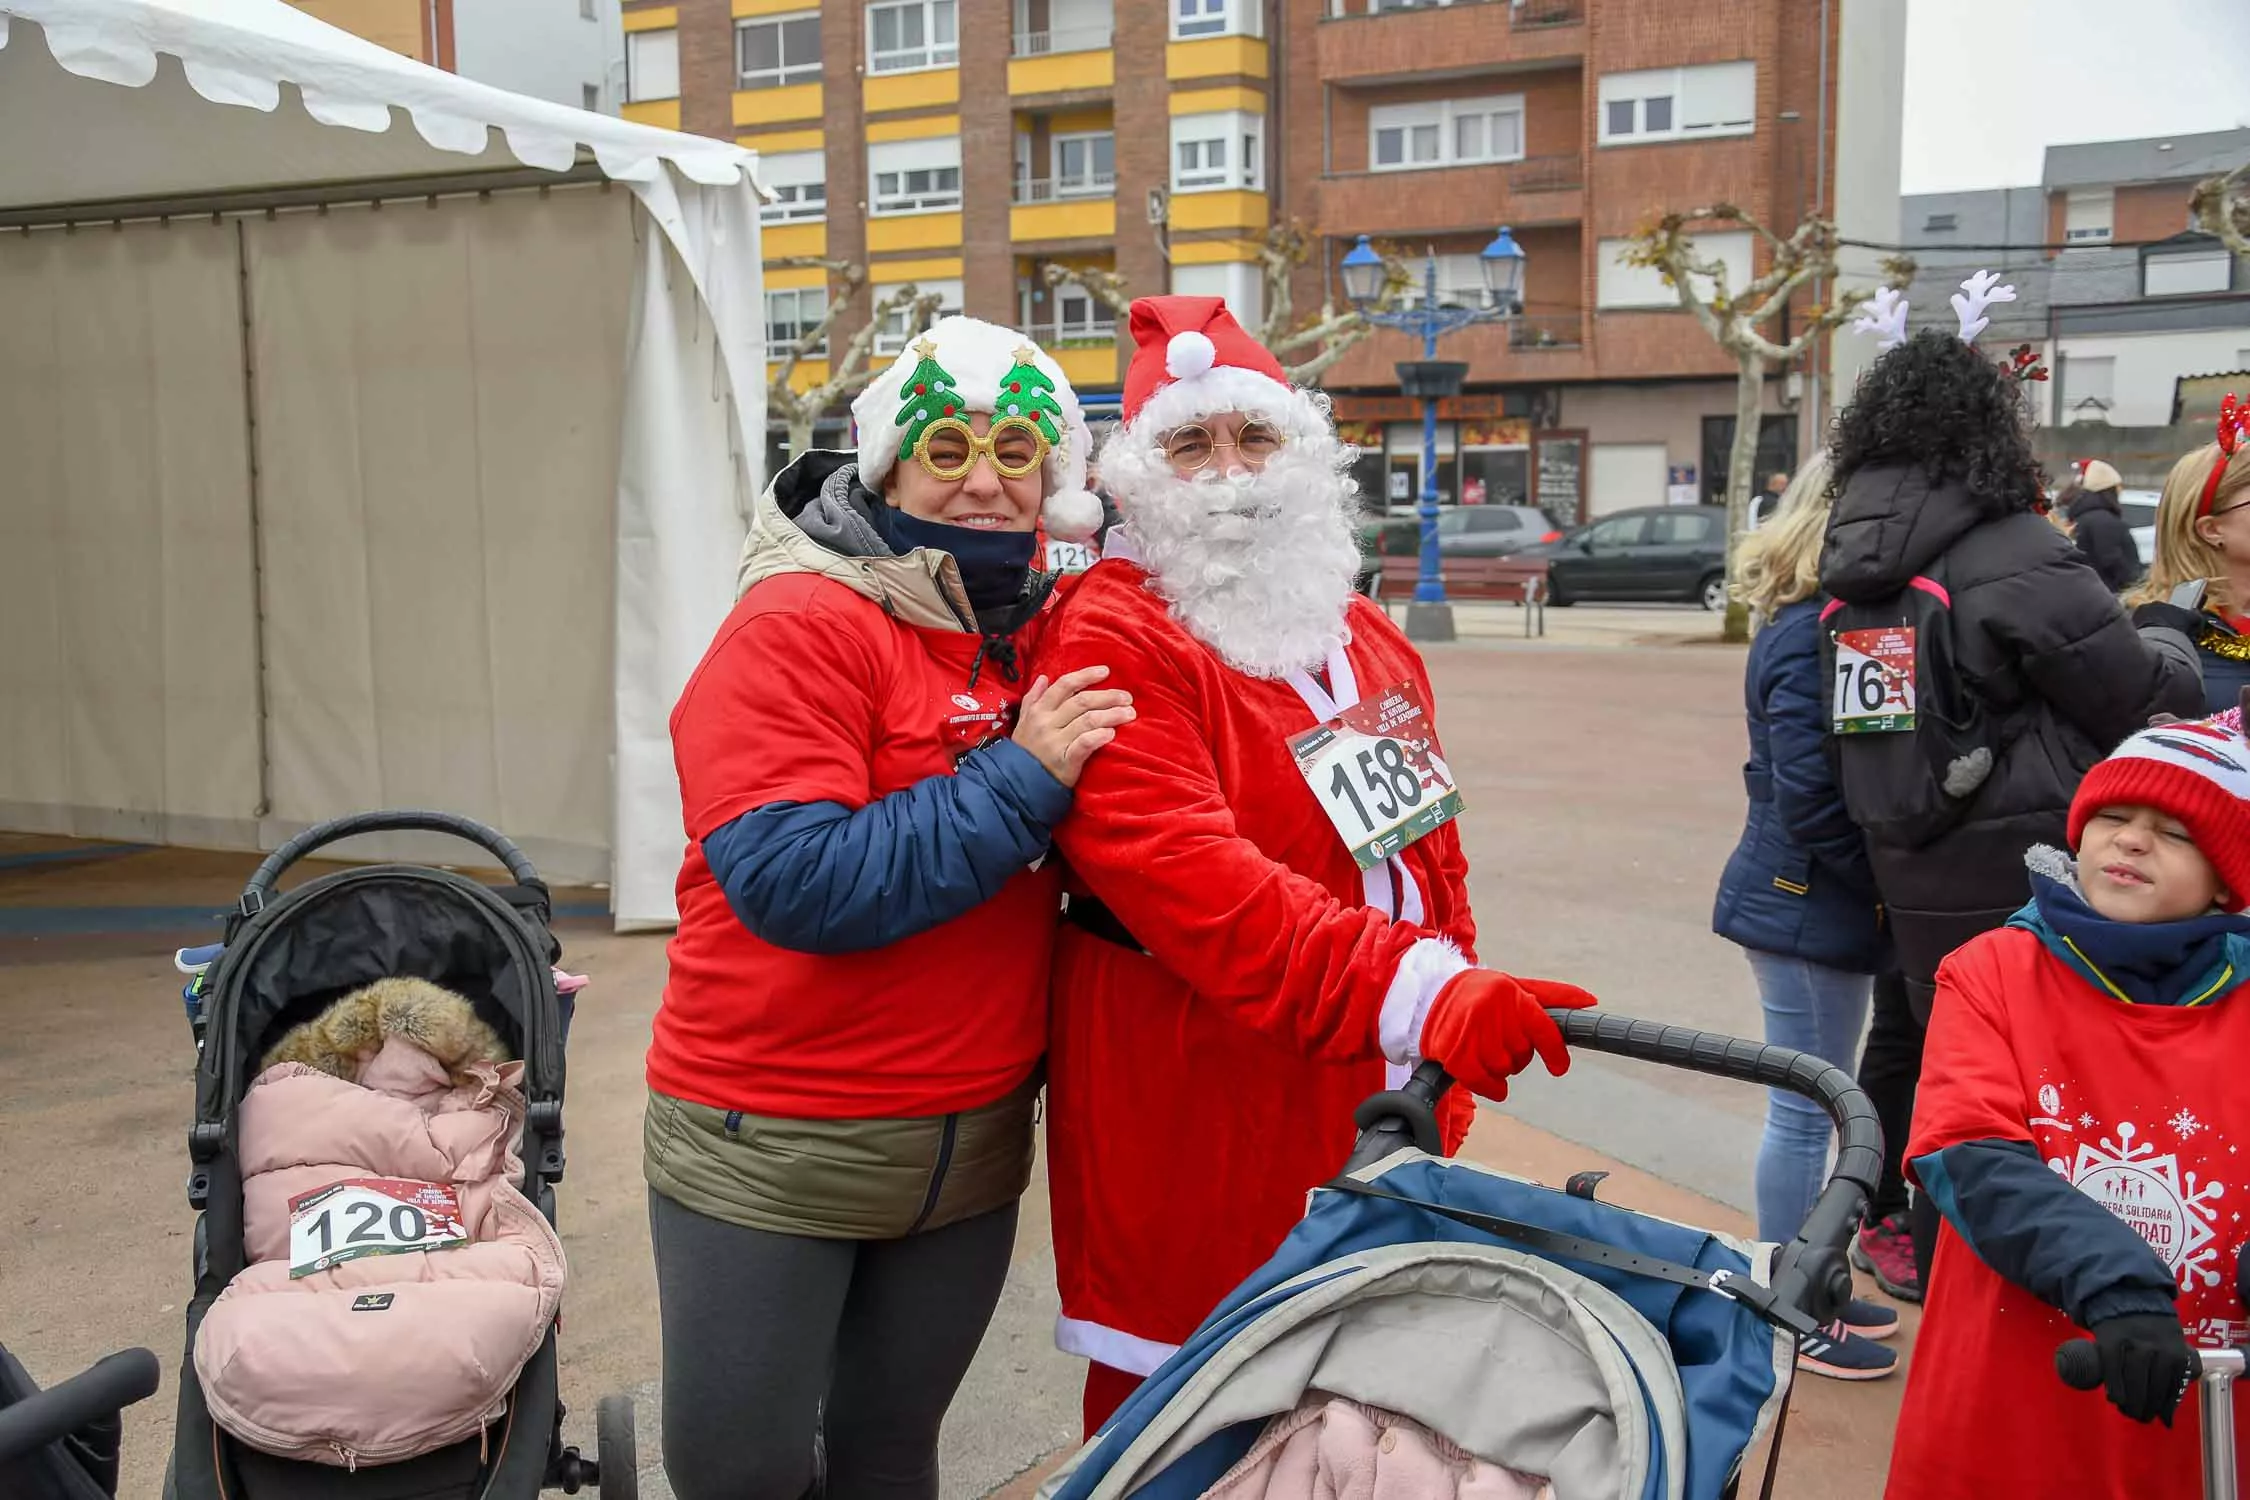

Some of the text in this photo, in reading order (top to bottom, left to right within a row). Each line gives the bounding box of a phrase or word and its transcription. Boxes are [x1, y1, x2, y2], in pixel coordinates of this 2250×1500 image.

[1053, 547, 1088, 567] 121
[1839, 660, 1885, 713] 76
[1330, 738, 1422, 833] 158
[307, 1201, 427, 1253] 120
[2125, 1204, 2173, 1221] SOLIDARIA
